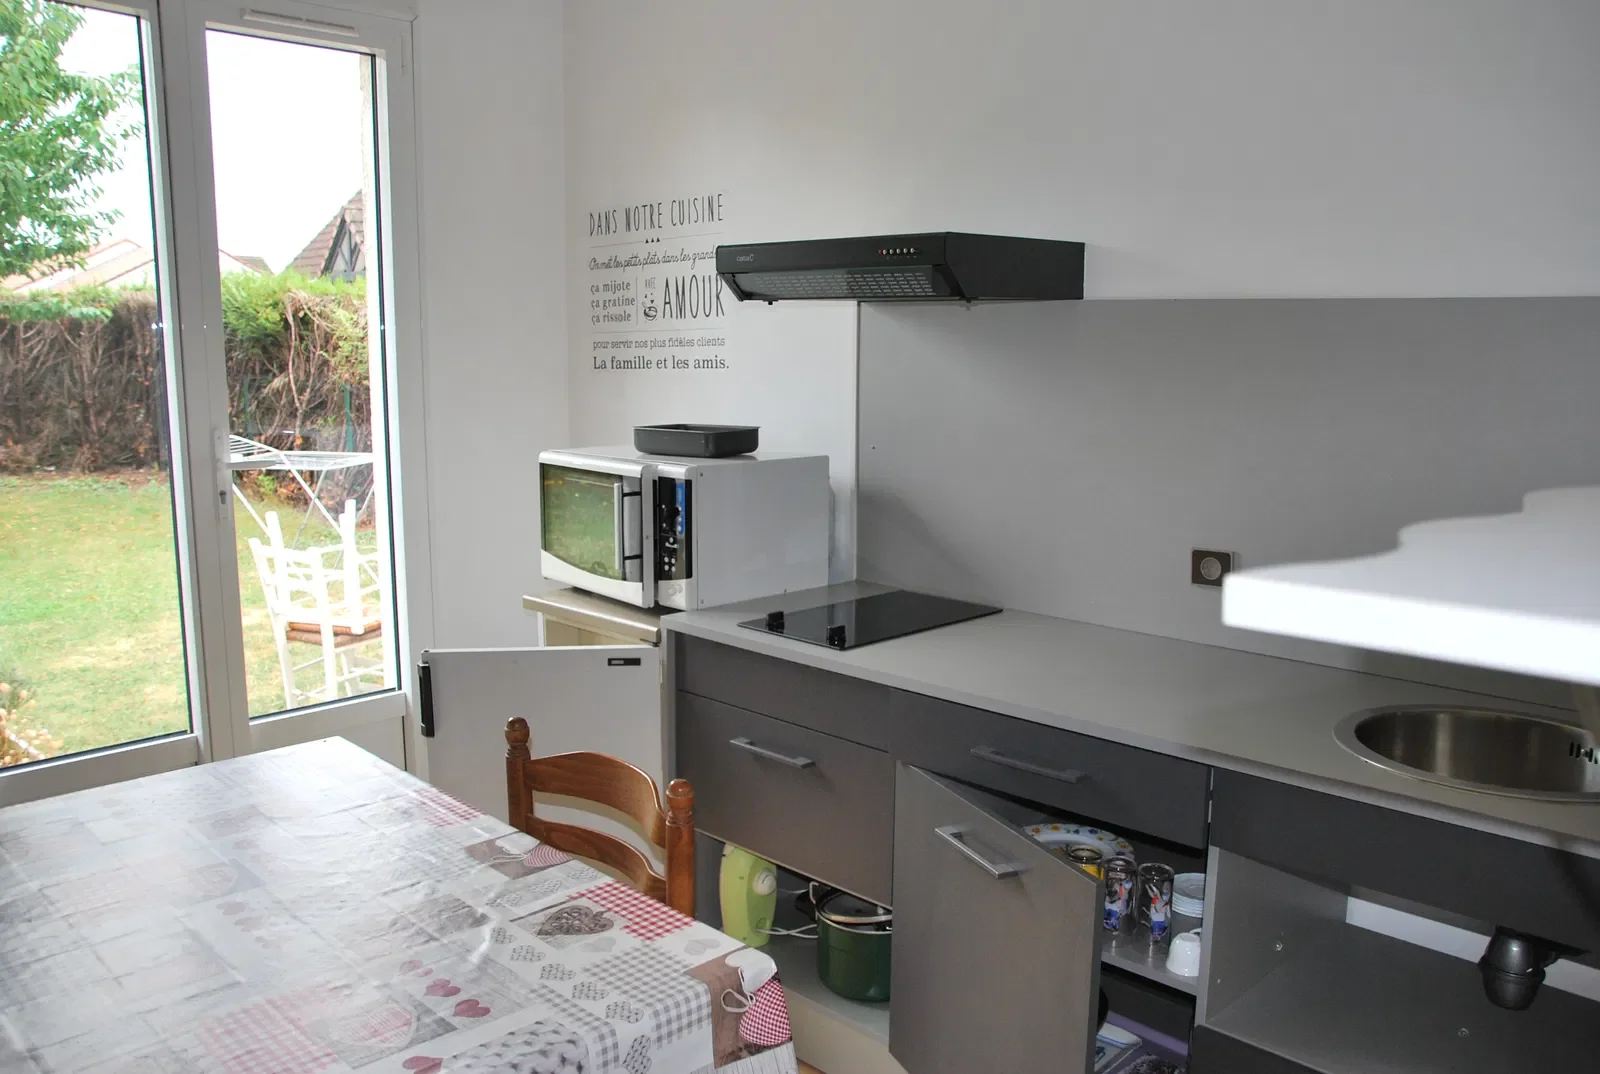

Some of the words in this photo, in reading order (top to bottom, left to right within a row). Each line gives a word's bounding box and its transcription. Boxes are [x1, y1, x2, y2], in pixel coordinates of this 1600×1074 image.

[589, 209, 617, 236] DANS
[625, 202, 663, 232] NOTRE
[671, 193, 723, 226] CUISINE
[600, 256, 613, 269] met
[613, 255, 622, 268] les
[622, 253, 640, 272] petits
[640, 252, 660, 271] plats
[661, 250, 679, 264] dans
[680, 248, 690, 262] les
[690, 245, 717, 270] grand
[590, 283, 600, 295] ça
[602, 281, 631, 294] mijote
[590, 299, 600, 310] ça
[602, 296, 636, 311] gratine
[662, 273, 725, 320] AMOUR
[591, 315, 600, 326] ça
[602, 310, 632, 323] rissole
[592, 340, 609, 351] pour
[610, 340, 632, 350] servir
[634, 339, 648, 349] nos
[649, 337, 666, 350] plus
[668, 337, 695, 348] fidèles
[696, 336, 725, 348] clients
[593, 356, 607, 370] La
[610, 355, 652, 370] famille
[656, 356, 668, 369] et
[671, 355, 689, 369] les
[693, 354, 730, 369] amis.
